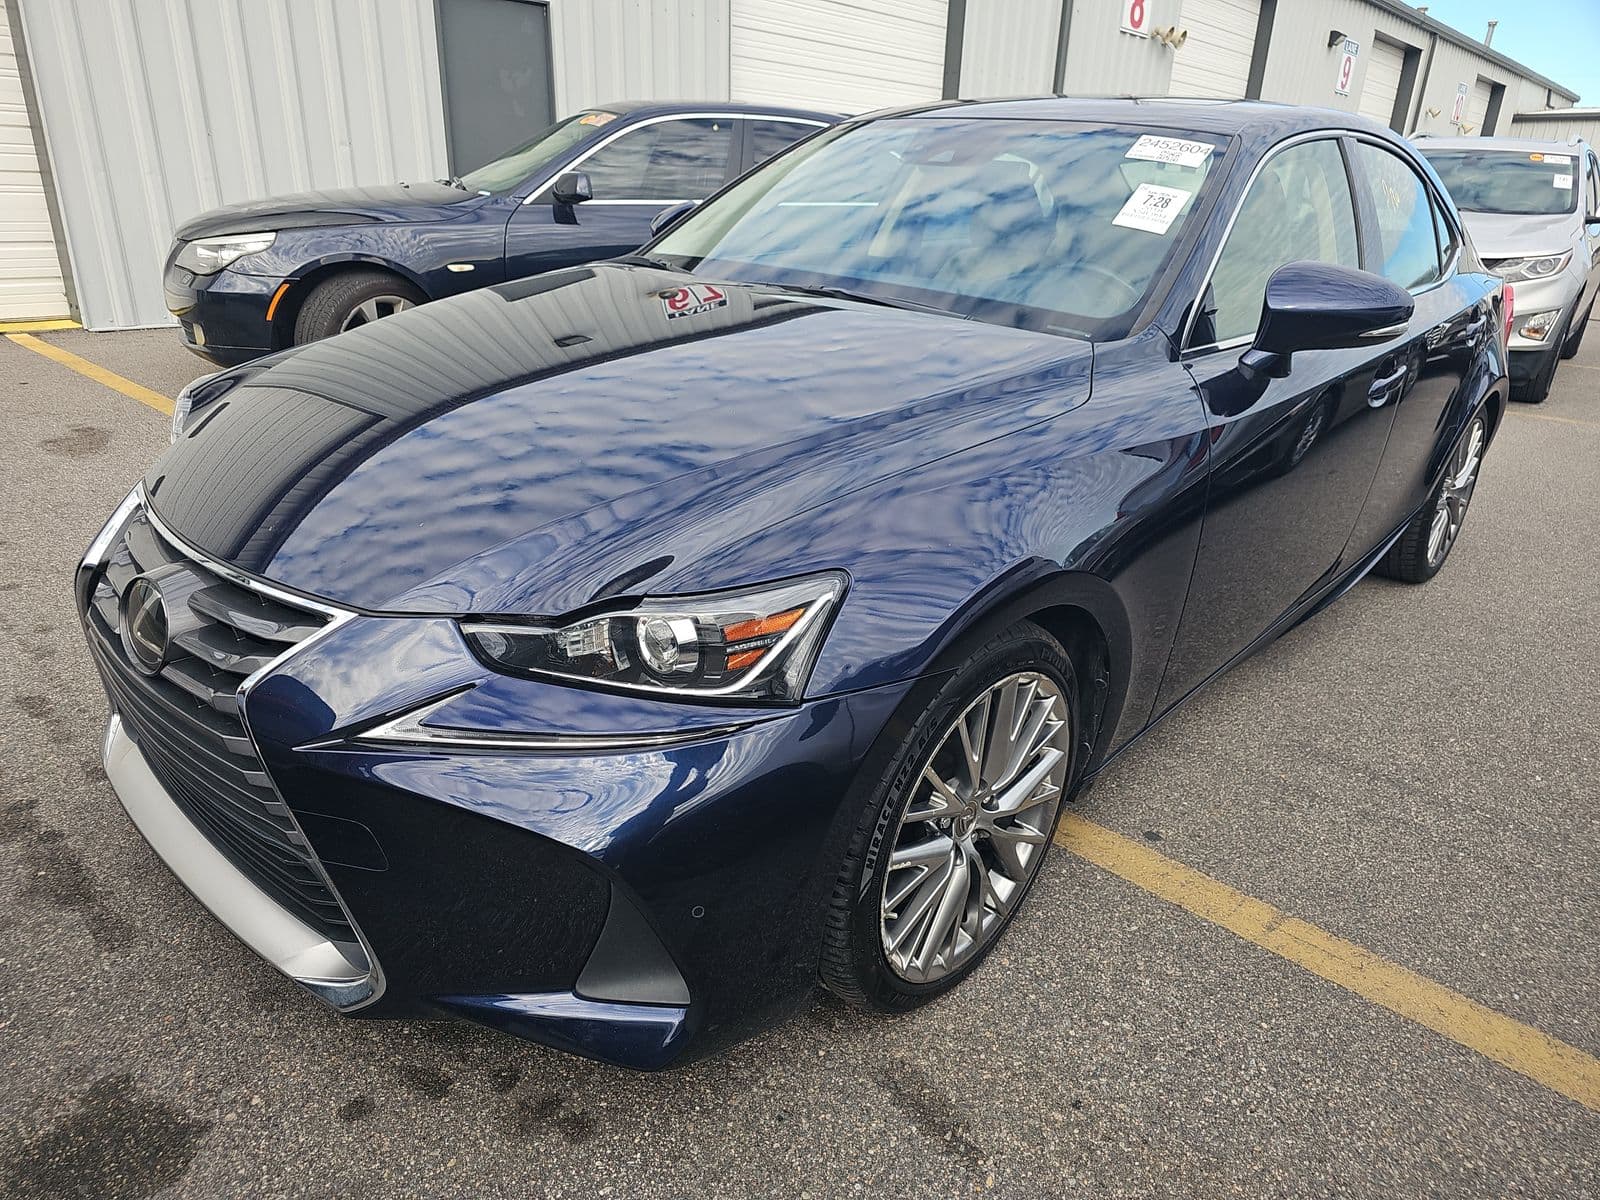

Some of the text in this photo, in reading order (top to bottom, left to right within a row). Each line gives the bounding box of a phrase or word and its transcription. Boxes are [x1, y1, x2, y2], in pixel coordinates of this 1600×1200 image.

[1341, 56, 1351, 89] 9
[1139, 137, 1210, 155] 2452604
[1143, 194, 1172, 209] 7:28
